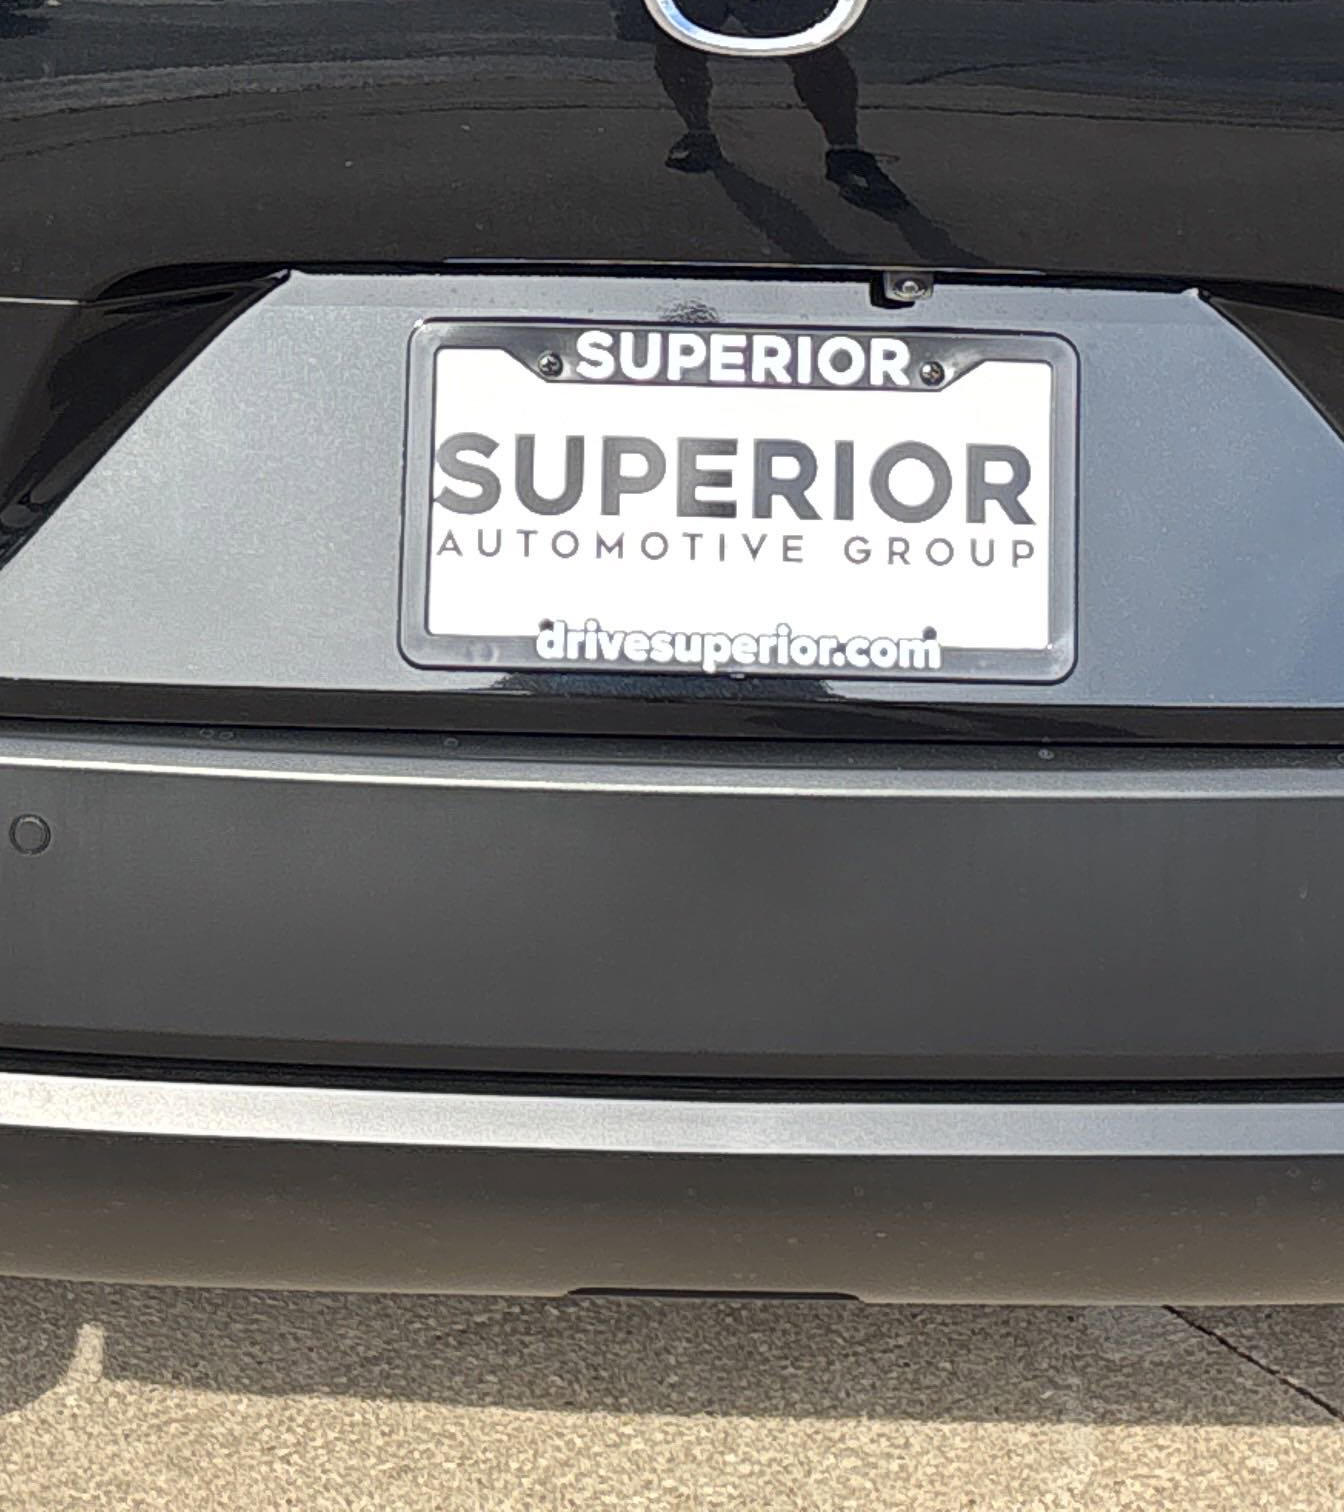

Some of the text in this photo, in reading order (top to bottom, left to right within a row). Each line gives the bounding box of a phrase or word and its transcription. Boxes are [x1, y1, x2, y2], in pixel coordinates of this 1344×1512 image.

[575, 330, 911, 387] SUPERIOR
[432, 432, 1036, 525] SUPERIOR
[436, 529, 1036, 568] AUTOMOTIVE GROUP
[536, 619, 942, 674] drivesuperior.com
